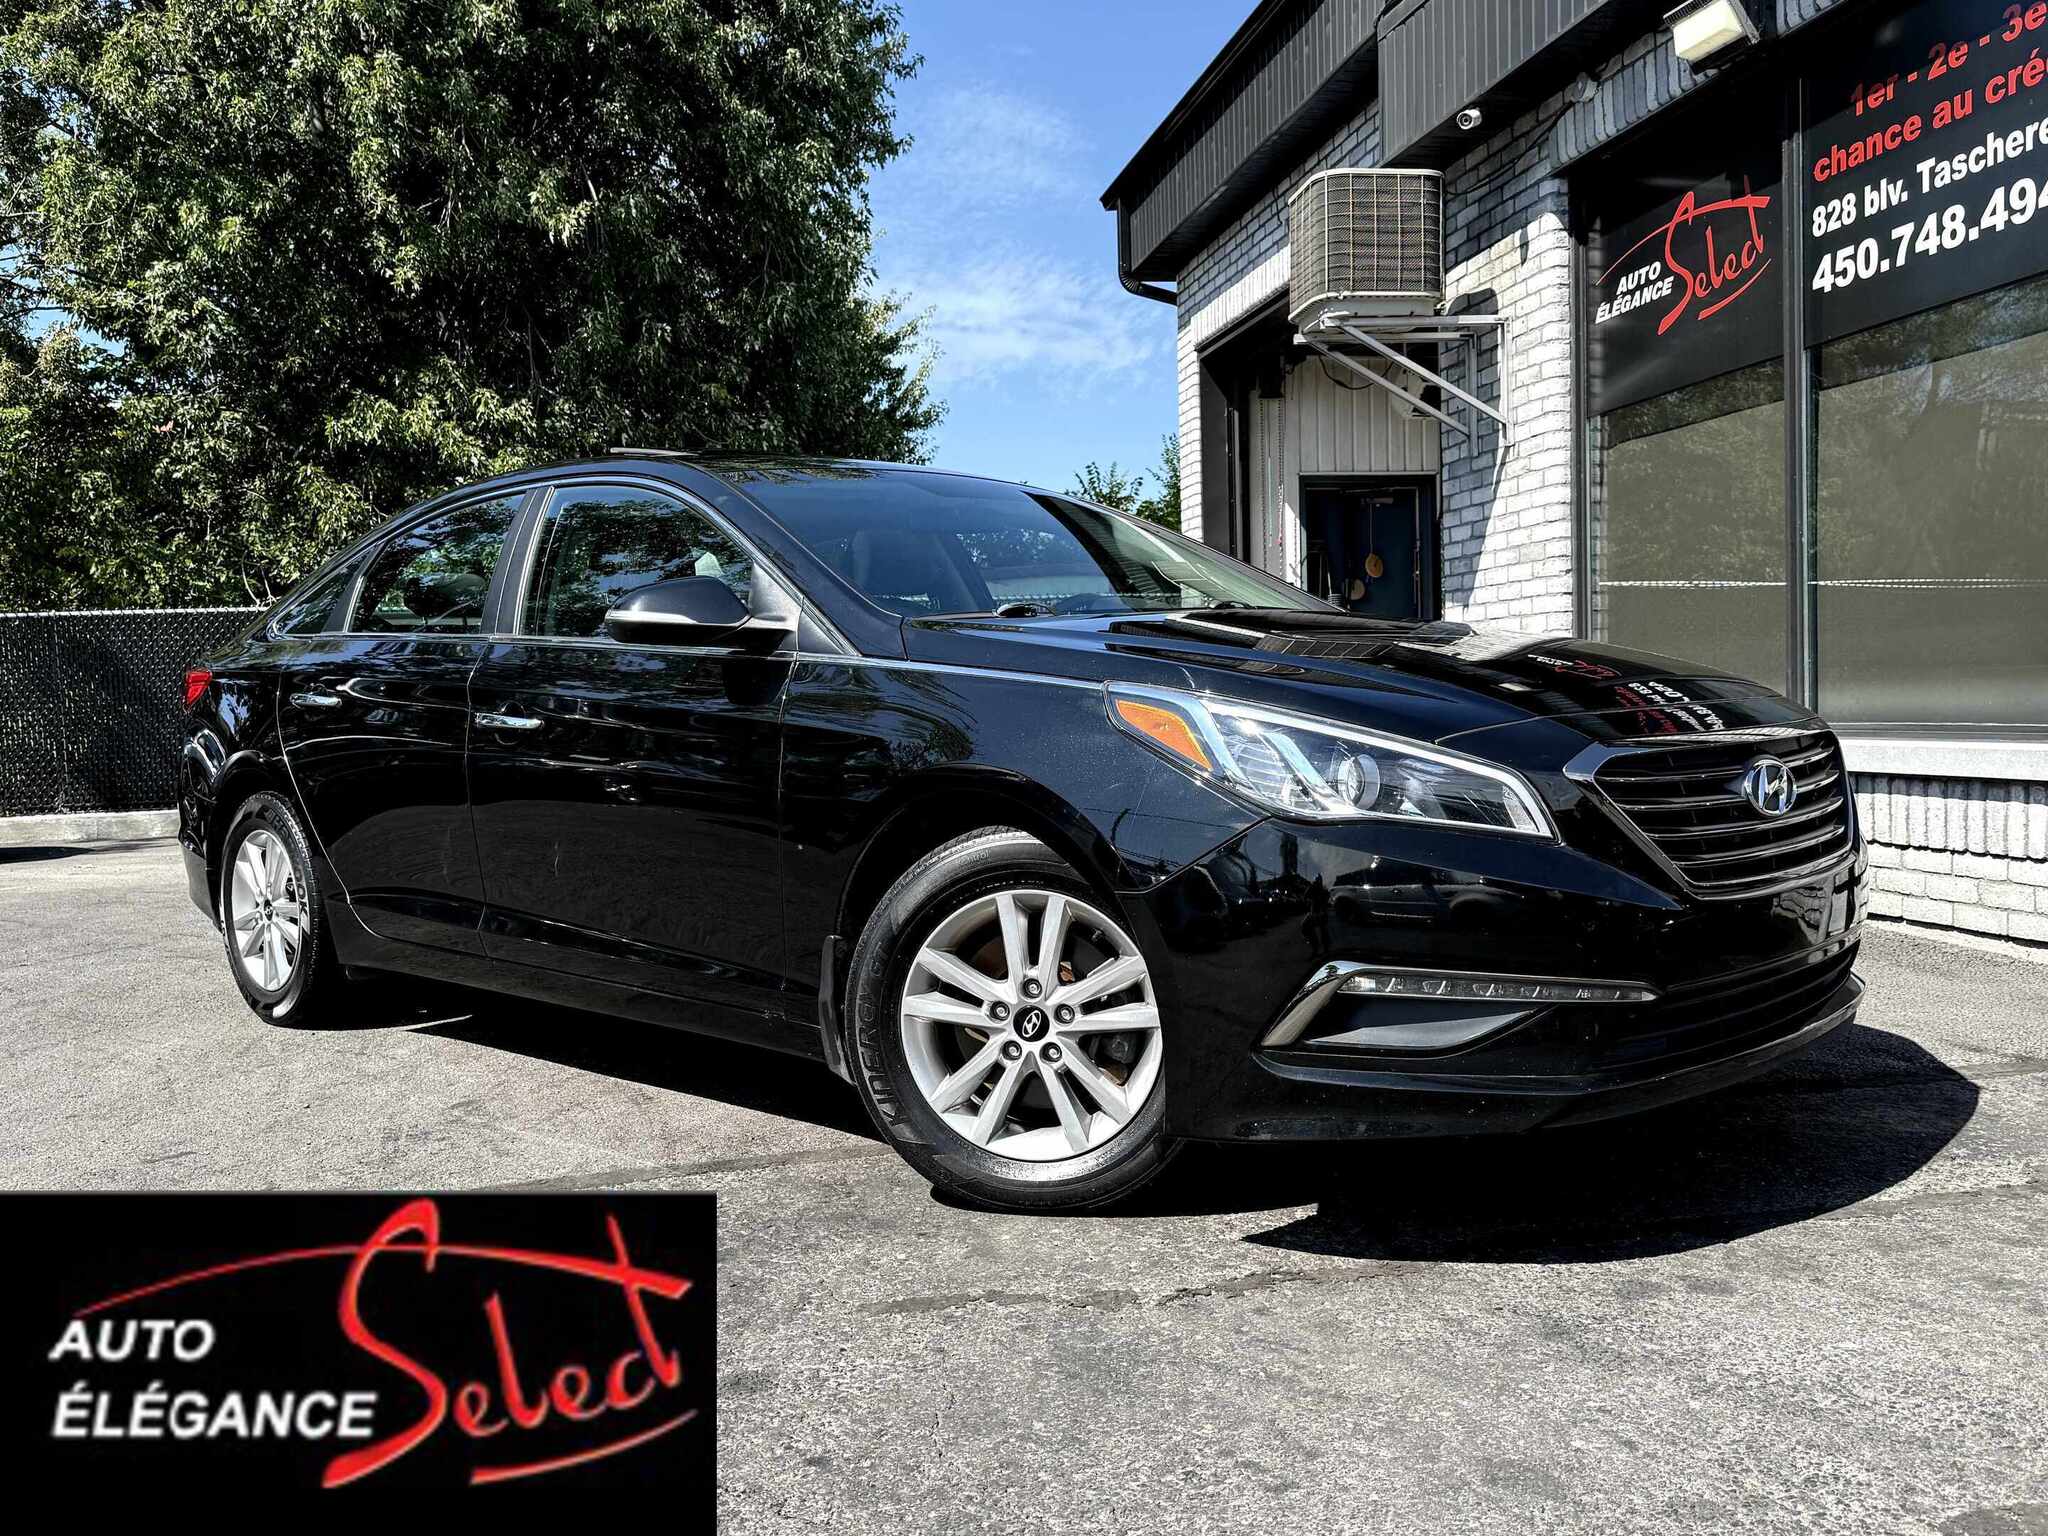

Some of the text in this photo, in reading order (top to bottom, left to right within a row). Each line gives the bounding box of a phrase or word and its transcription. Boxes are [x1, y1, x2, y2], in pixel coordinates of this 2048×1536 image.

[1850, 73, 1899, 117] 1er
[1927, 41, 1969, 81] 2e
[2002, 1, 2047, 42] 3e
[1813, 47, 2048, 181] chance au cré
[1812, 192, 1857, 239] 828
[1864, 177, 1908, 218] blv.
[1595, 275, 1676, 325] ÉLÉGANCE
[1616, 260, 1662, 296] AUTO
